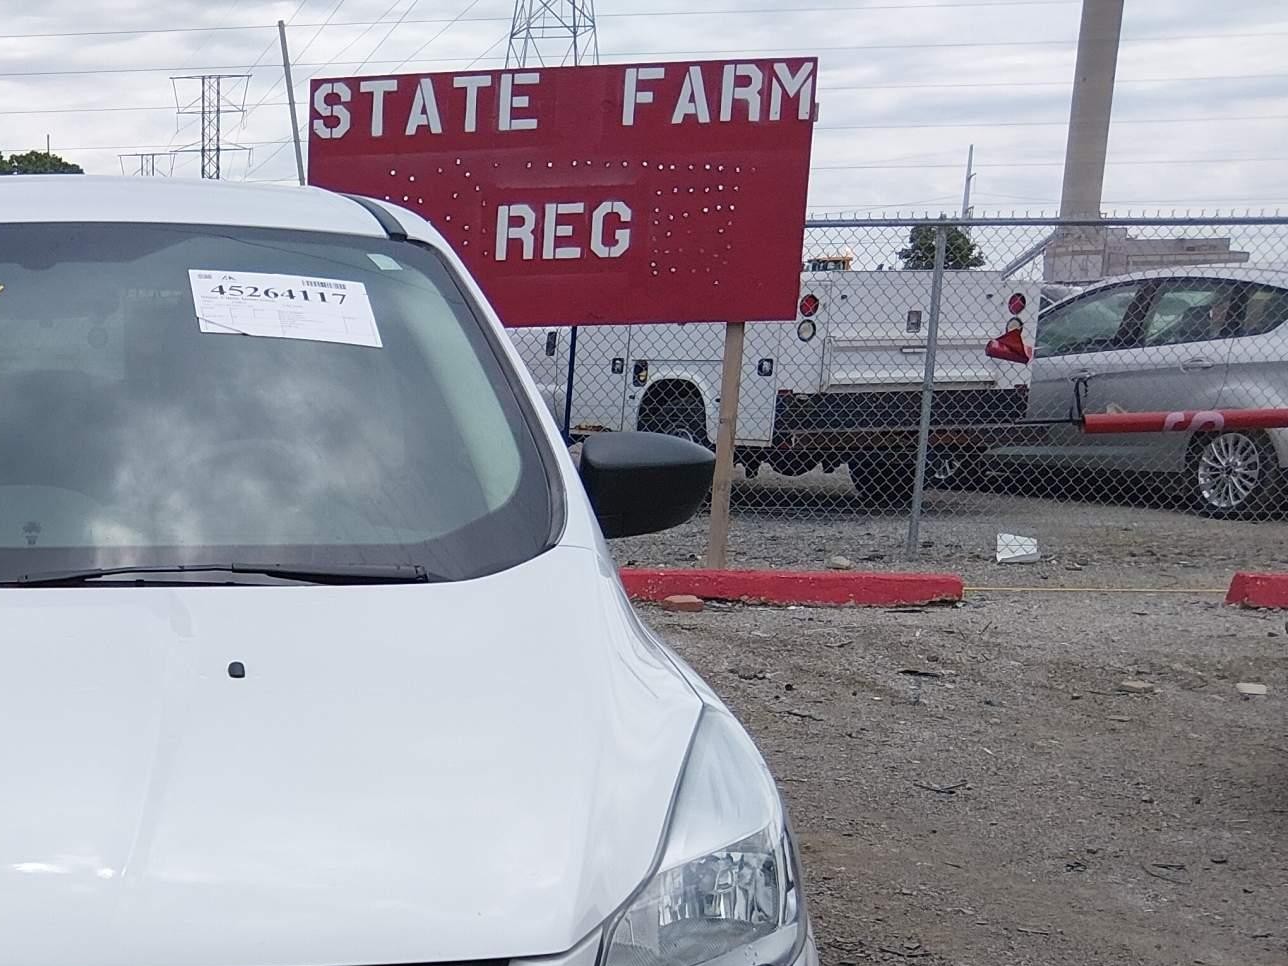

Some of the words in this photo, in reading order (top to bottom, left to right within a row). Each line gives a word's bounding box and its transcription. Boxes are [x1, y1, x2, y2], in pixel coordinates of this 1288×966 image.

[312, 73, 541, 138] STATE
[622, 62, 814, 126] FARM
[495, 202, 632, 260] REG
[210, 284, 348, 305] 45264117
